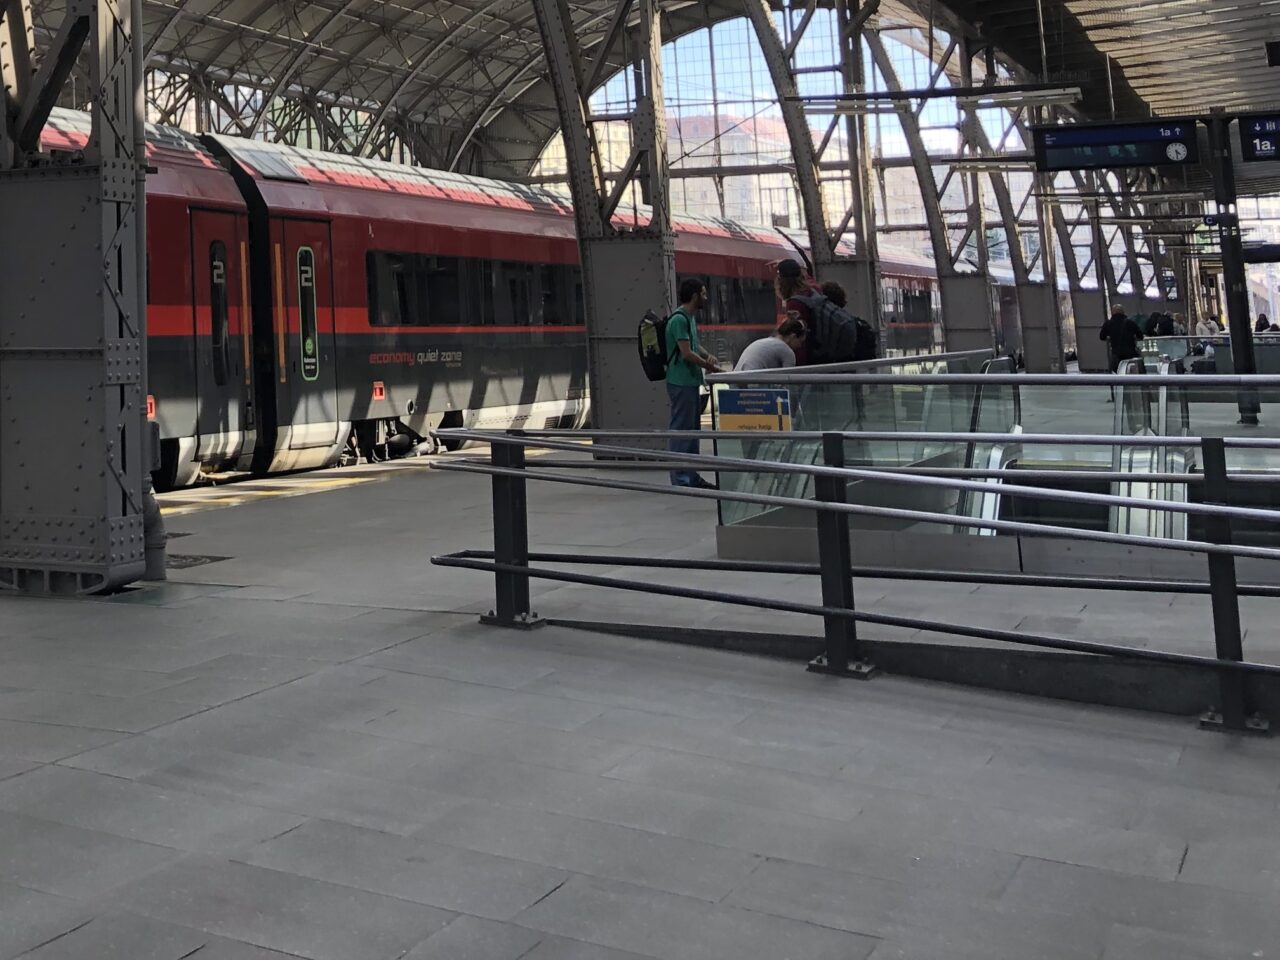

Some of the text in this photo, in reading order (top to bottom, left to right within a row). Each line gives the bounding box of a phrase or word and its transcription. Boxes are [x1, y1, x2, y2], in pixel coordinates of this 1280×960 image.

[1159, 127, 1171, 137] 1a
[212, 260, 225, 283] 2
[300, 266, 312, 286] 2
[368, 348, 462, 366] economy quiet zone
